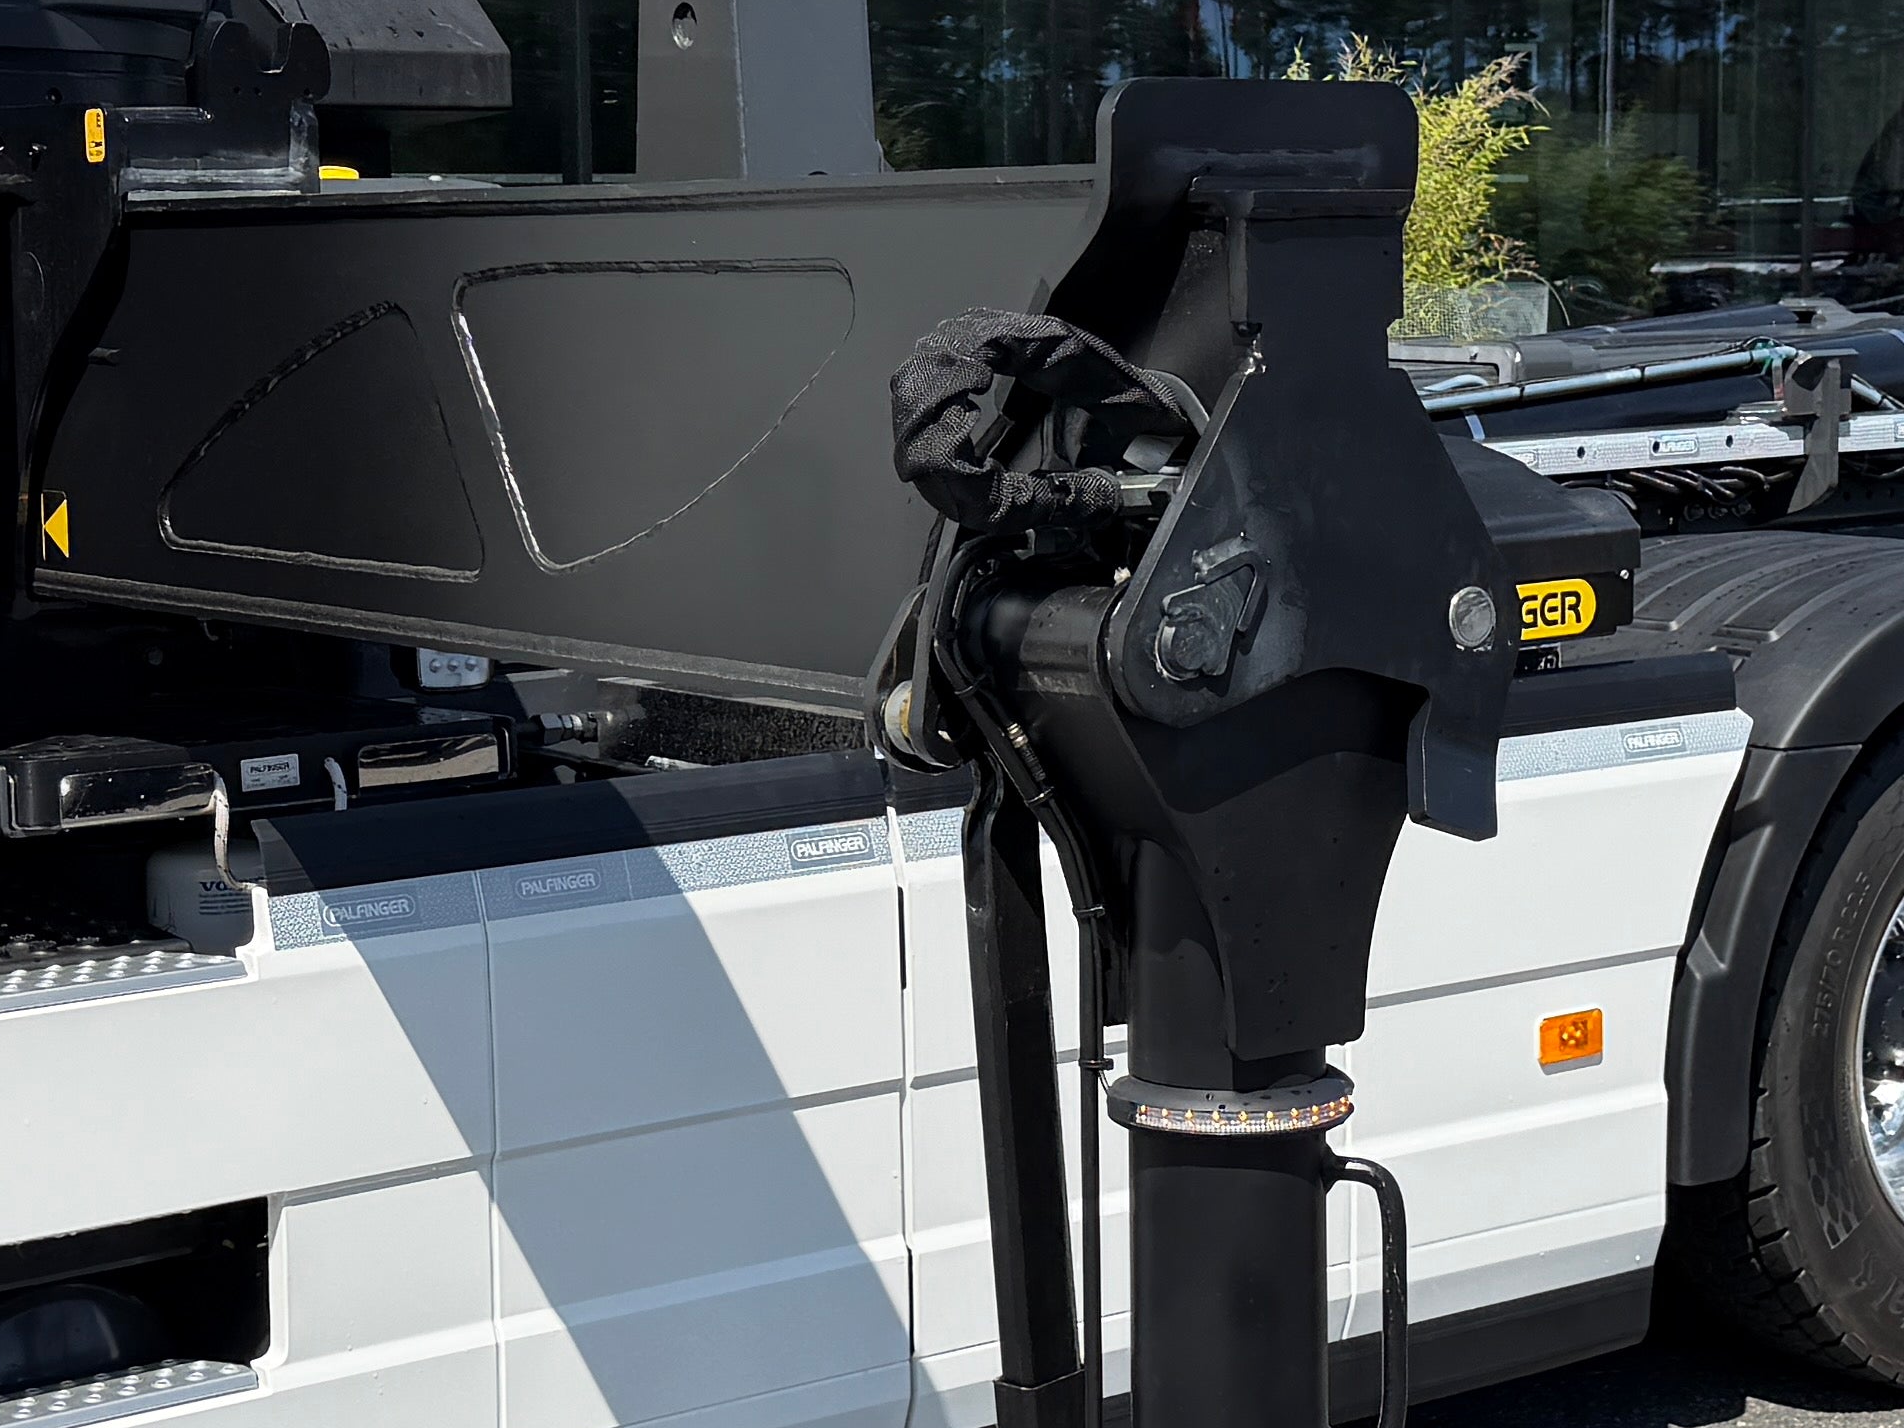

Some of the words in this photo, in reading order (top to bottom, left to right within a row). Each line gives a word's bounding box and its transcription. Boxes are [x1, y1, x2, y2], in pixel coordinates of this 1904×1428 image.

[795, 835, 866, 859] PALFINGER
[520, 872, 597, 897] PALFINGER
[328, 897, 410, 923] PALFINGER
